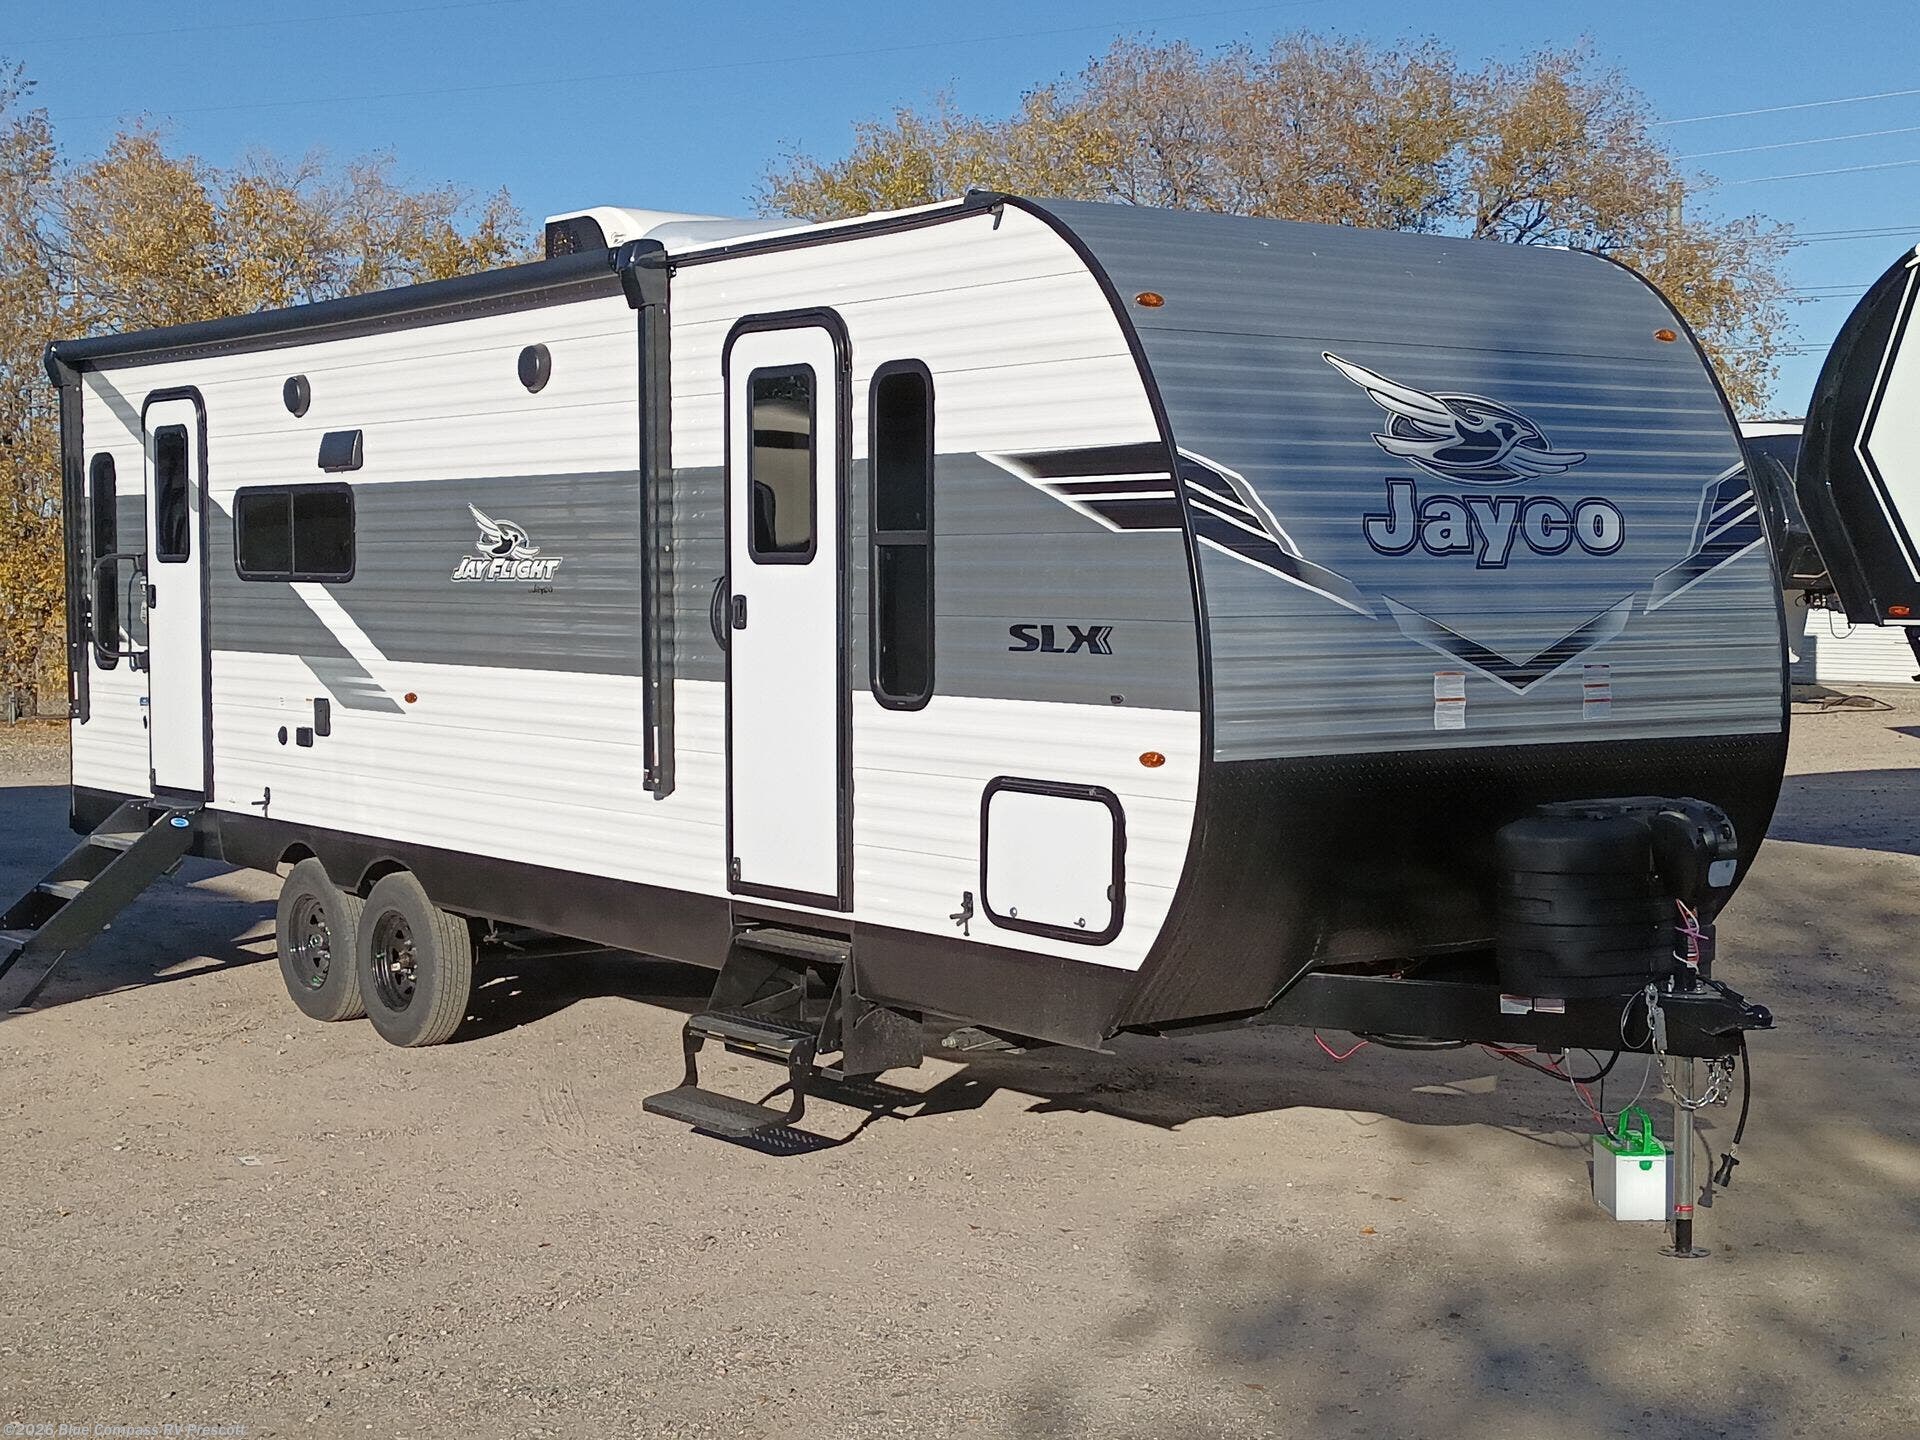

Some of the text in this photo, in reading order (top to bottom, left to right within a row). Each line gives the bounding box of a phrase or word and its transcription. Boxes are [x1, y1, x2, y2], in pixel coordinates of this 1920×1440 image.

[1363, 477, 1625, 569] Jayco
[451, 556, 563, 582] JAY FLIGHT
[1008, 624, 1113, 655] SLX
